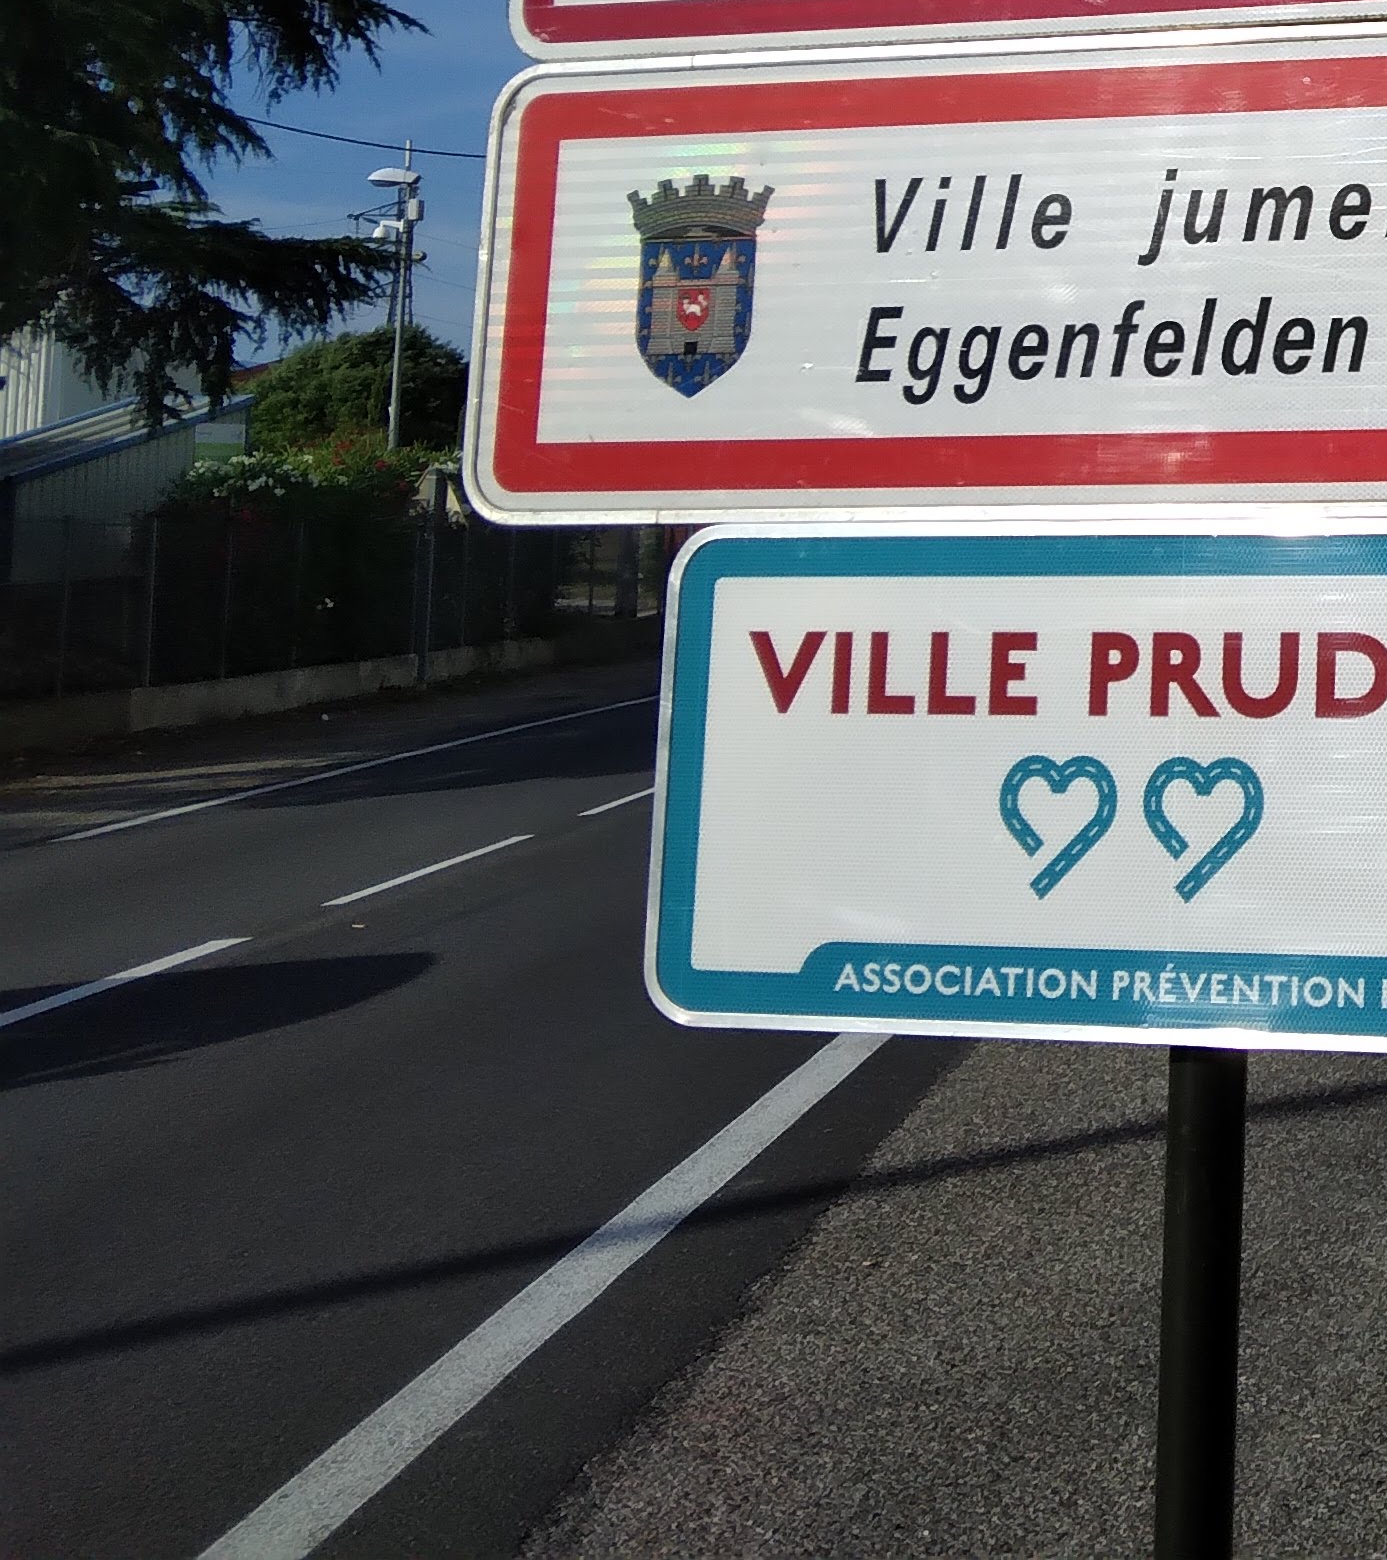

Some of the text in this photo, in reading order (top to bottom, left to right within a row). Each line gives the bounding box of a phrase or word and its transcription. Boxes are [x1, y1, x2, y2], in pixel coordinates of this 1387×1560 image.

[873, 173, 1074, 253] Ville
[855, 297, 1369, 407] Eggenfelden
[748, 630, 1039, 716] VILLE
[834, 962, 1098, 1001] ASSOCIATION
[1111, 963, 1366, 1009] PRÉVENTION
